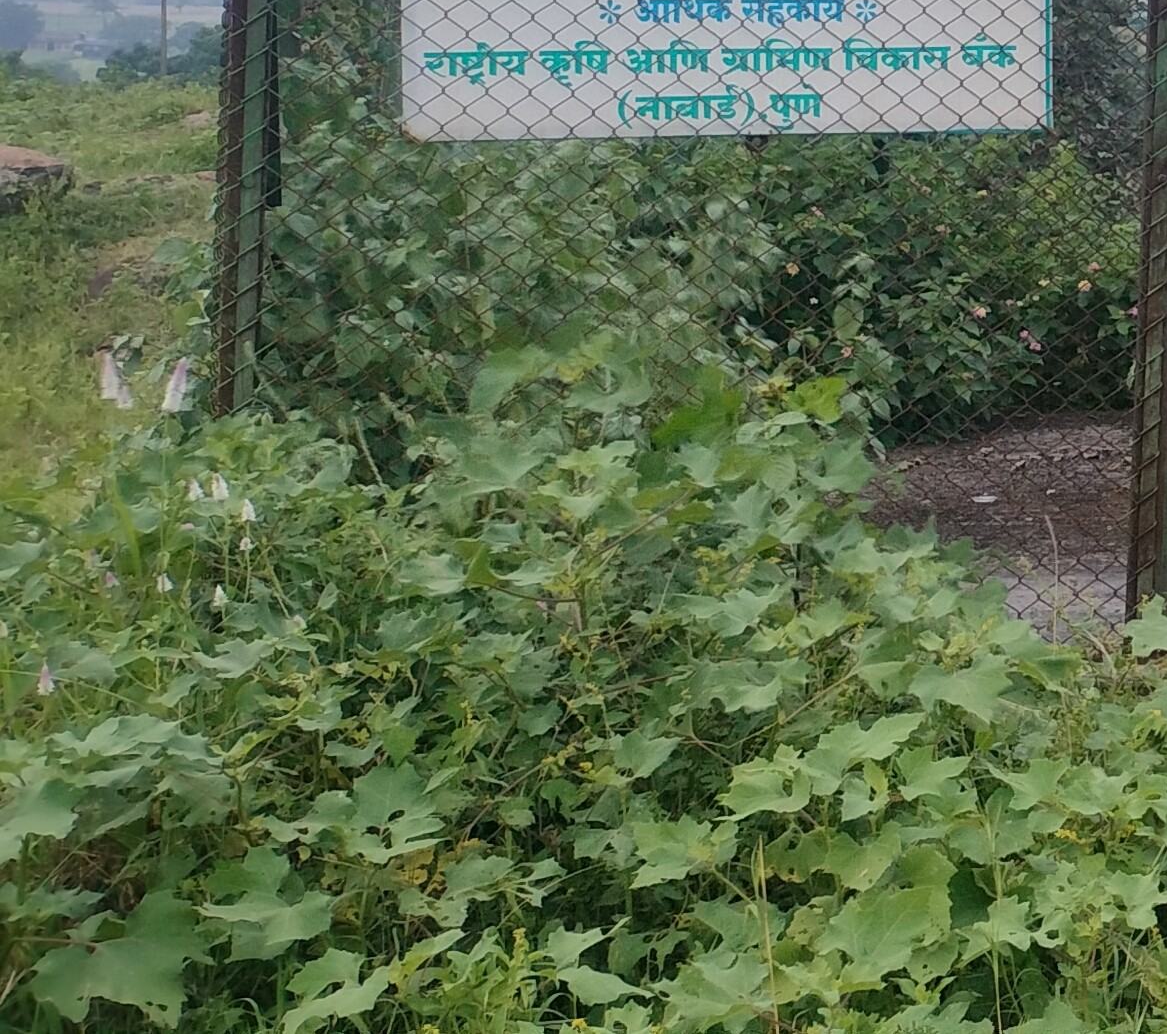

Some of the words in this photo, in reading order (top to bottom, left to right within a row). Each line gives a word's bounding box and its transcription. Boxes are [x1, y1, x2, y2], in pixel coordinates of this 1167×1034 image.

[424, 42, 529, 85] राष्ट्रीय
[539, 40, 611, 88] कृषि
[622, 40, 711, 74] आणि
[842, 38, 950, 71] विकास
